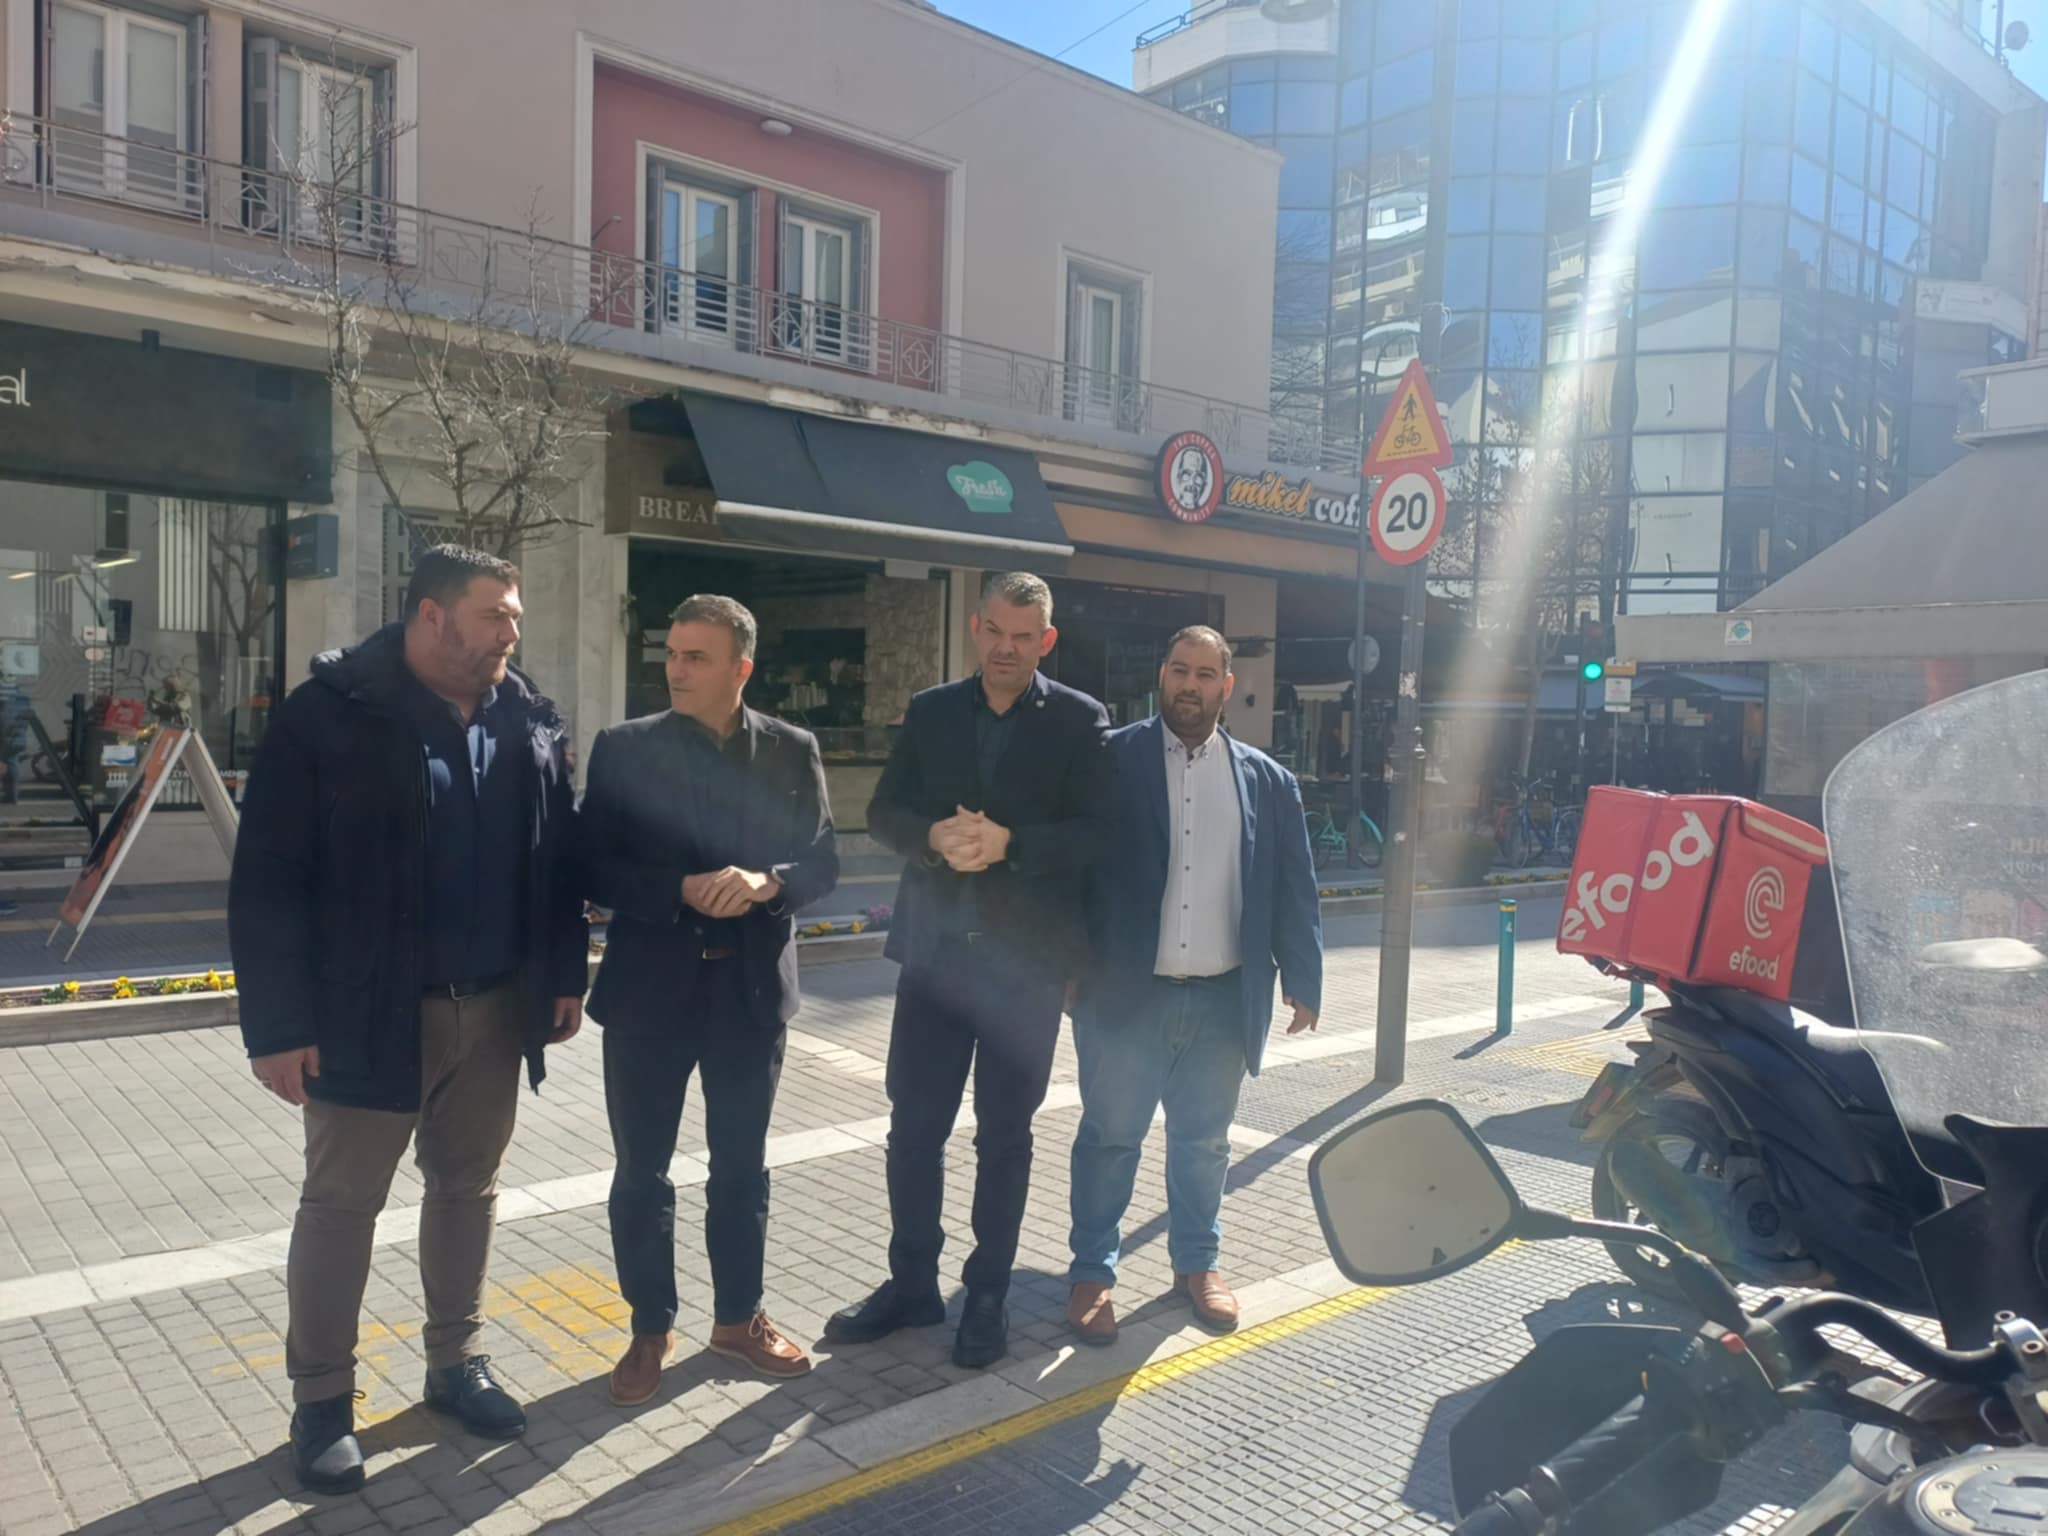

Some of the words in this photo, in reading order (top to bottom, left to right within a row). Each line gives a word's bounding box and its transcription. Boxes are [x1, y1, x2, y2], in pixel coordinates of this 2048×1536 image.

[639, 495, 718, 525] BREA
[1228, 471, 1314, 516] mikel
[1386, 492, 1428, 534] 20
[1561, 811, 1715, 942] efood
[1729, 945, 1779, 980] efood
